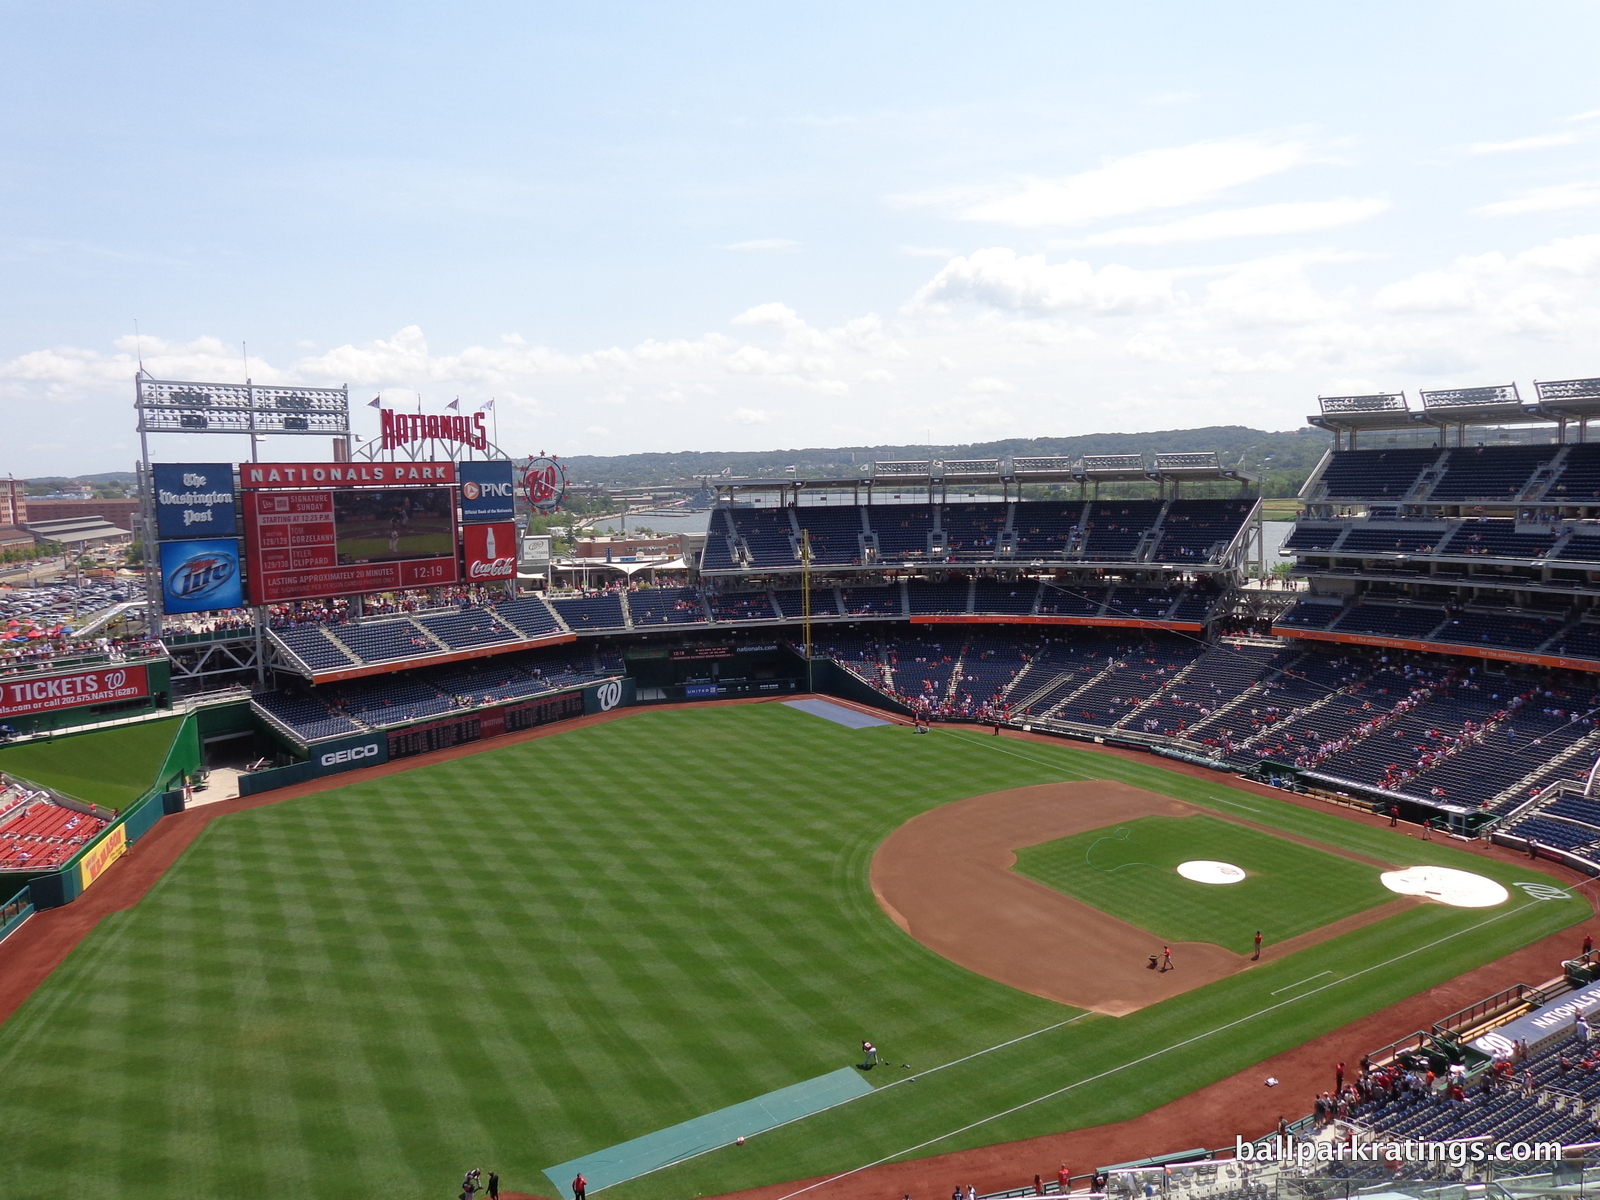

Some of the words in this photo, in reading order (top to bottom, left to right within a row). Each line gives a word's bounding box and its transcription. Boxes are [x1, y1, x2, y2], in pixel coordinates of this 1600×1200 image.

[381, 409, 486, 450] NATIONALS
[183, 473, 207, 488] The
[251, 468, 384, 482] NATIONALS
[395, 466, 446, 480] PARK
[481, 483, 512, 497] PNC
[159, 489, 233, 507] Washington
[290, 494, 328, 503] SIGNATURE
[296, 503, 323, 511] SUNDAY
[183, 509, 213, 526] Post
[262, 516, 291, 524] STARTING
[293, 515, 300, 523] AT
[301, 514, 318, 522] 12:25
[291, 527, 304, 535] TOM
[291, 534, 334, 544] GORZELANNY
[292, 550, 312, 558] TYLER
[293, 557, 329, 567] CLIPPARD
[470, 557, 515, 578] Coca-Cola
[181, 563, 228, 596] Lite
[267, 576, 298, 586] LASTING
[300, 572, 355, 584] APPROXIMATELY
[356, 570, 365, 578] 20
[365, 568, 394, 577] MINUTES
[413, 565, 443, 579] 12:19
[280, 585, 310, 594] SIGNATURE
[323, 581, 344, 589] PERSON
[363, 578, 382, 586] PHOTOS
[736, 644, 777, 653] nationals.com
[1497, 652, 1521, 660] achiever
[10, 674, 98, 702] TICKETS
[44, 698, 60, 708] call
[61, 690, 114, 705] 202.675.NATS
[115, 686, 138, 698] (6287)
[321, 744, 378, 767] GEICO
[1531, 994, 1597, 1029] NATIONALS
